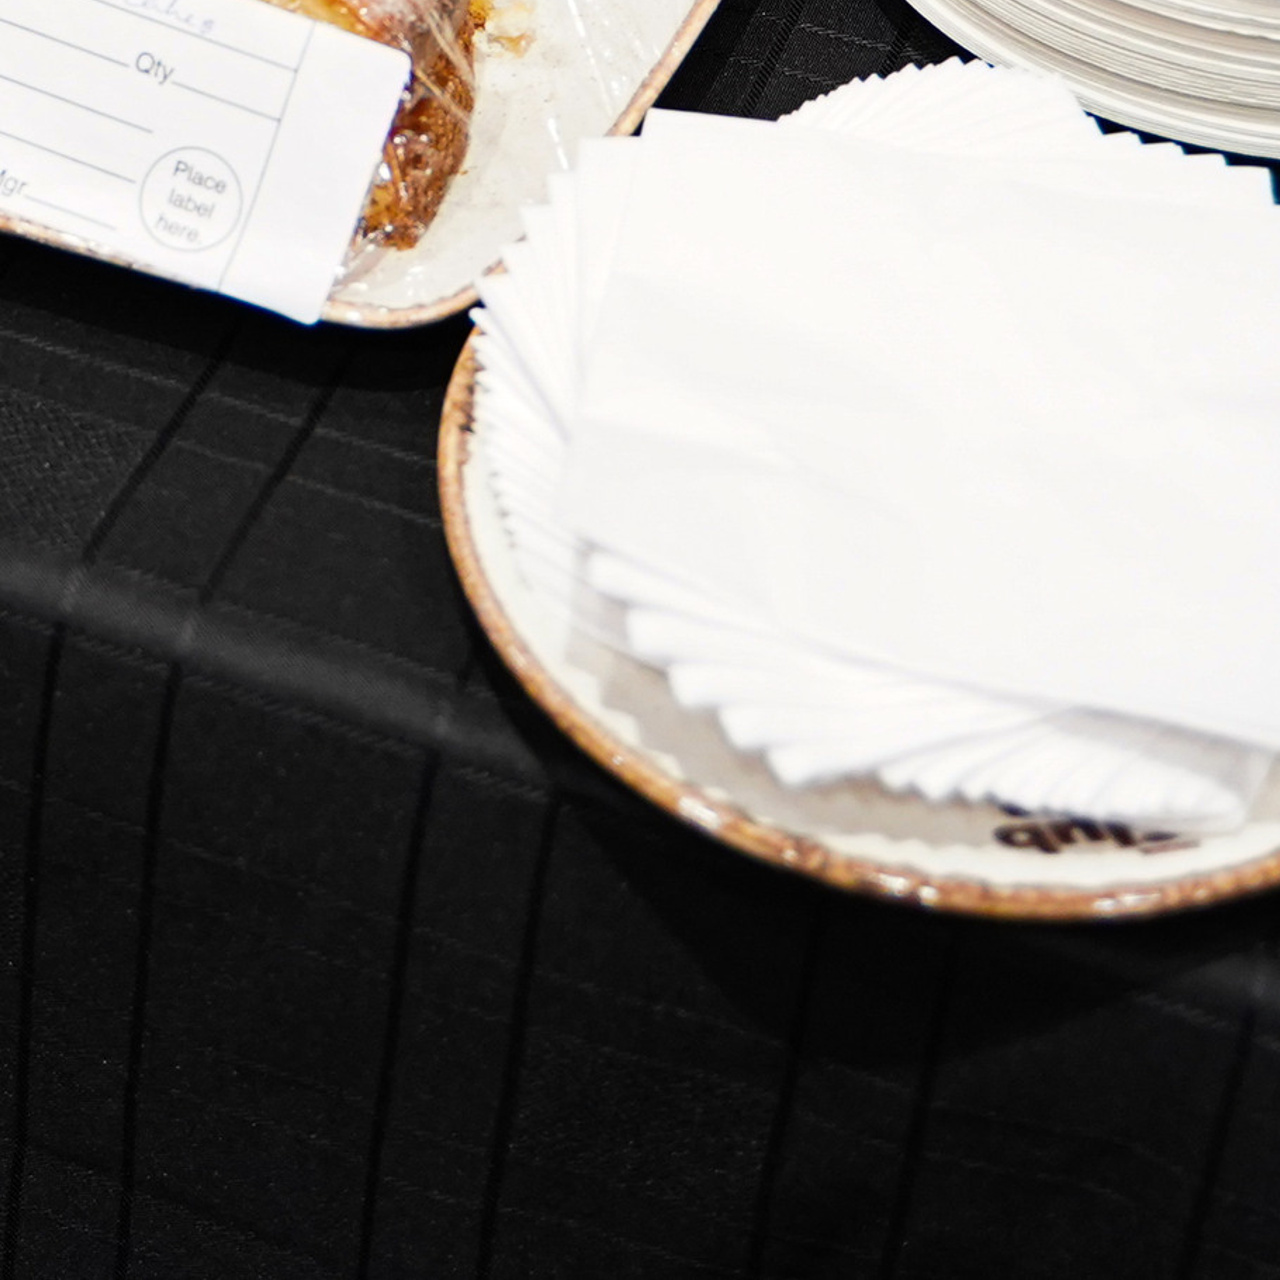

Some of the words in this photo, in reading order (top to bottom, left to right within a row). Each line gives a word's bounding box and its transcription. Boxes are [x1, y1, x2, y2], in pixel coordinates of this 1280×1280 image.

[135, 51, 174, 85] Qty
[172, 160, 228, 195] Place
[167, 189, 216, 220] label
